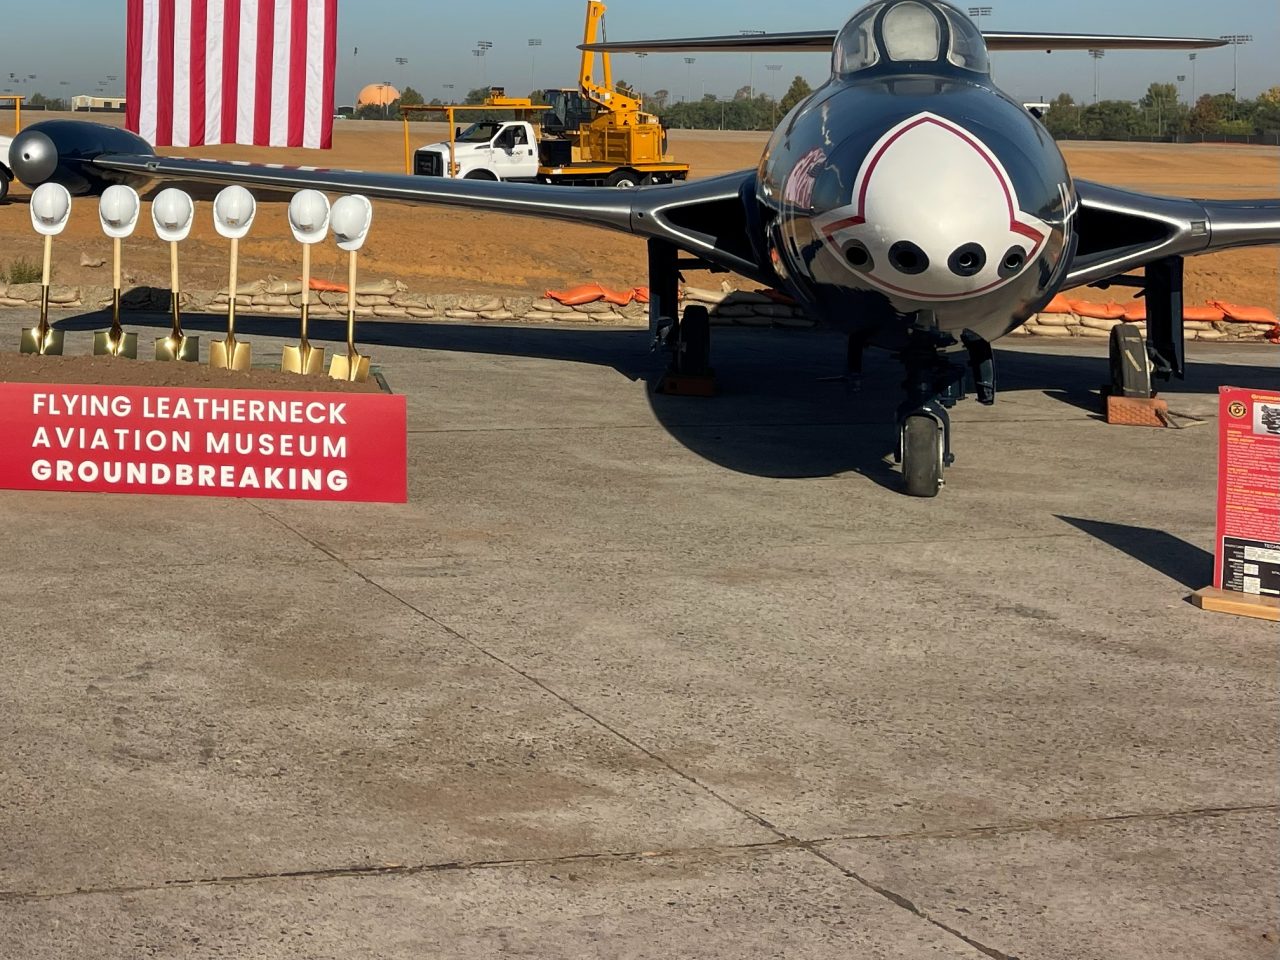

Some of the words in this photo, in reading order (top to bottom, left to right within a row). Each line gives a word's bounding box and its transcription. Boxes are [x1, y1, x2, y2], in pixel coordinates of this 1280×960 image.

[32, 393, 132, 417] FLYING
[143, 397, 347, 425] LEATHERNECK
[31, 426, 191, 453] AVIATION
[206, 432, 347, 458] MUSEUM
[31, 459, 349, 492] GROUNDBREAKING
